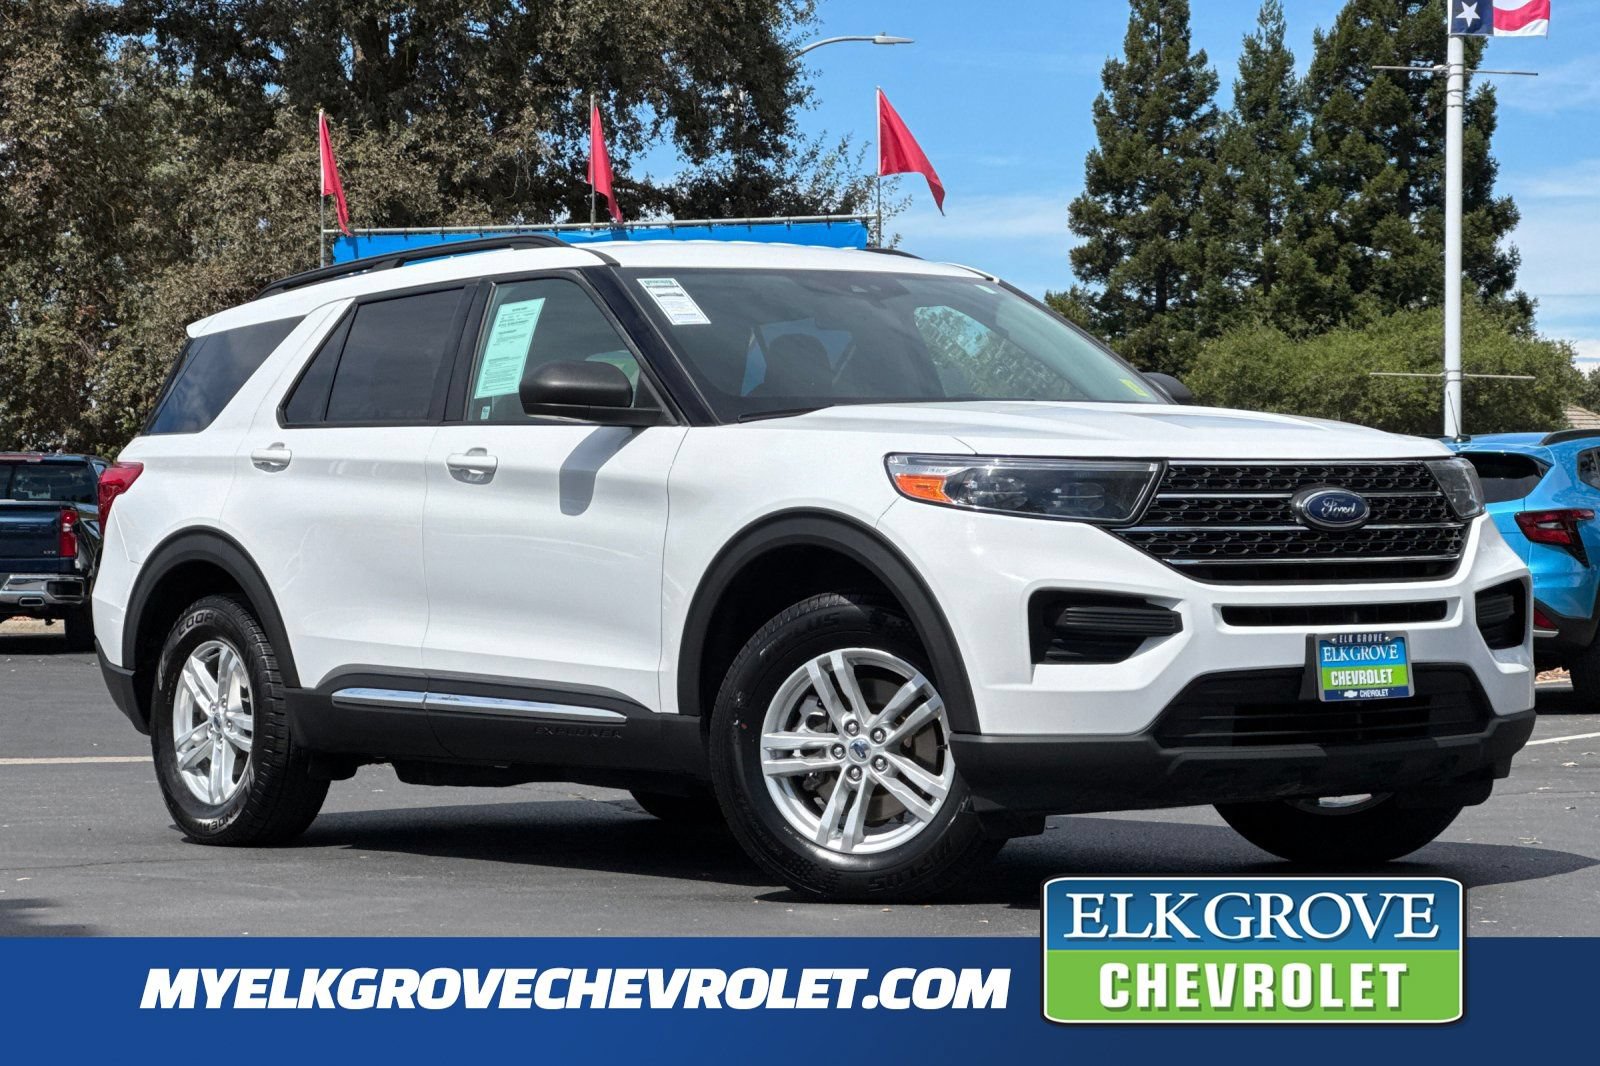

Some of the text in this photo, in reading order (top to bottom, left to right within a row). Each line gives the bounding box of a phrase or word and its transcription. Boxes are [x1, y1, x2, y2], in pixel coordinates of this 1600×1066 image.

[1321, 498, 1356, 516] Ford
[1339, 633, 1383, 643] ELK GROVE
[1323, 645, 1399, 662] ELK GROVE
[1331, 668, 1393, 686] CHEVROLET
[1360, 688, 1389, 698] CHEVROLET
